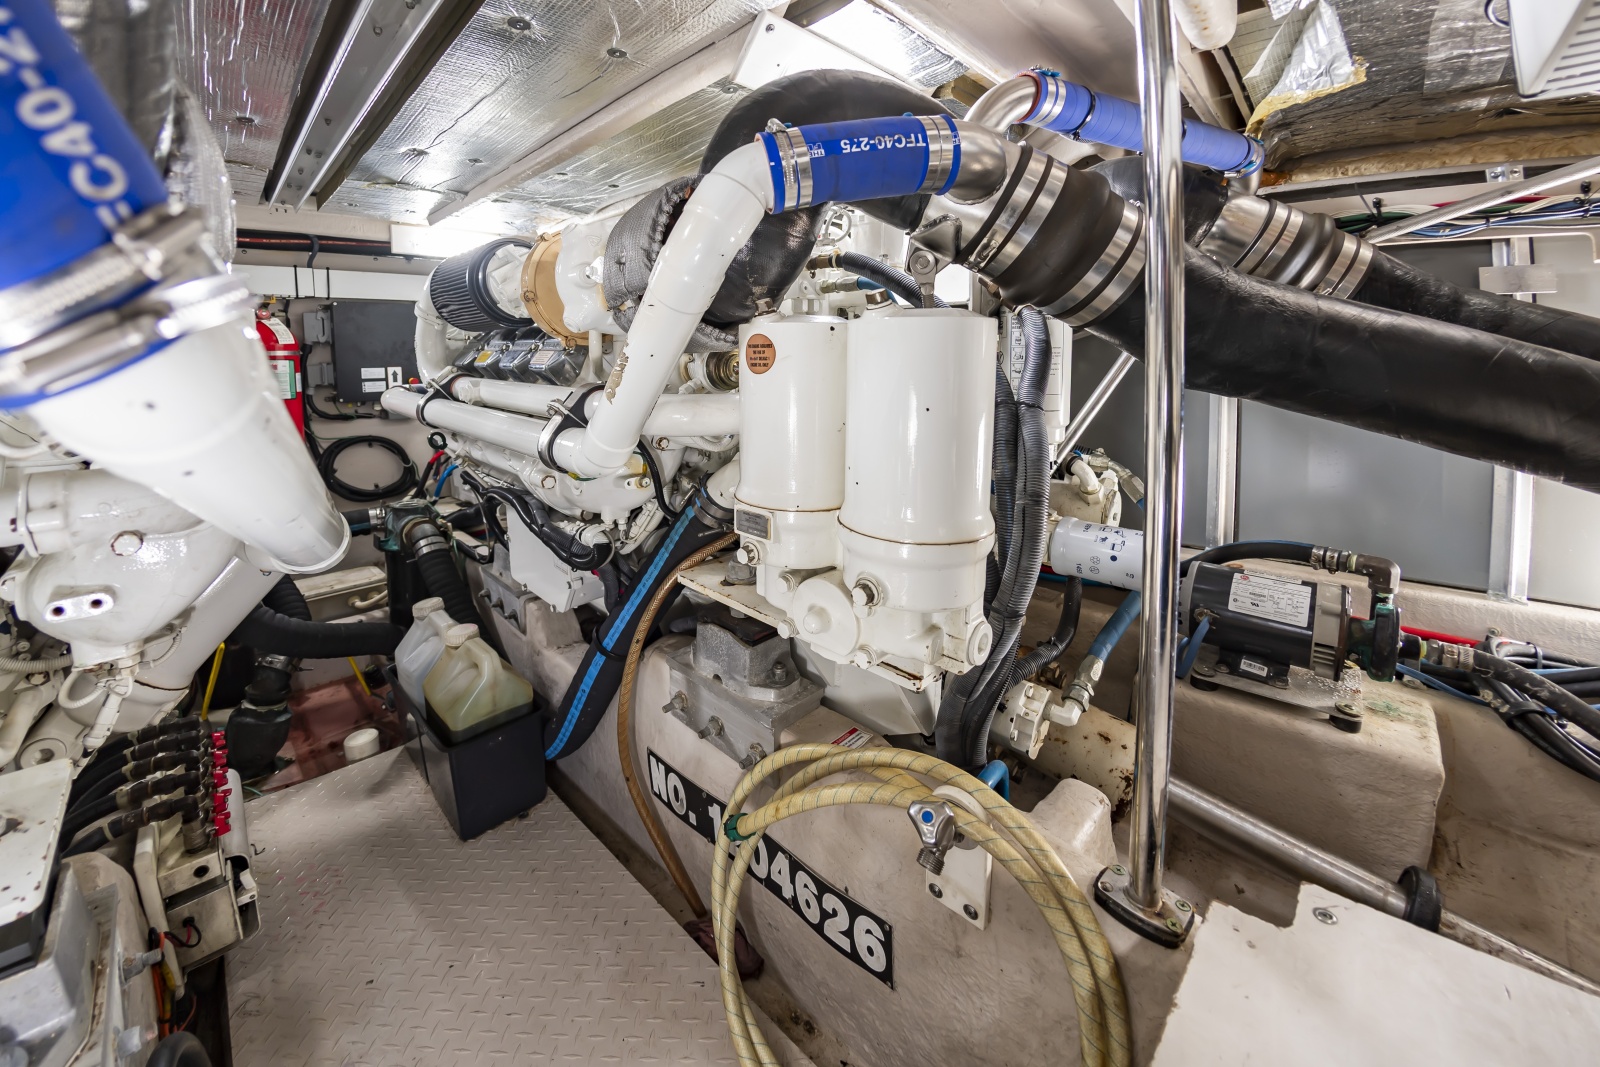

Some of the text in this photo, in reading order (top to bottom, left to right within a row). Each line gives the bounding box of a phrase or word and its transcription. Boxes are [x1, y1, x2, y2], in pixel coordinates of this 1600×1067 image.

[840, 133, 926, 153] TFC40-275
[649, 755, 887, 973] NO. 104626
